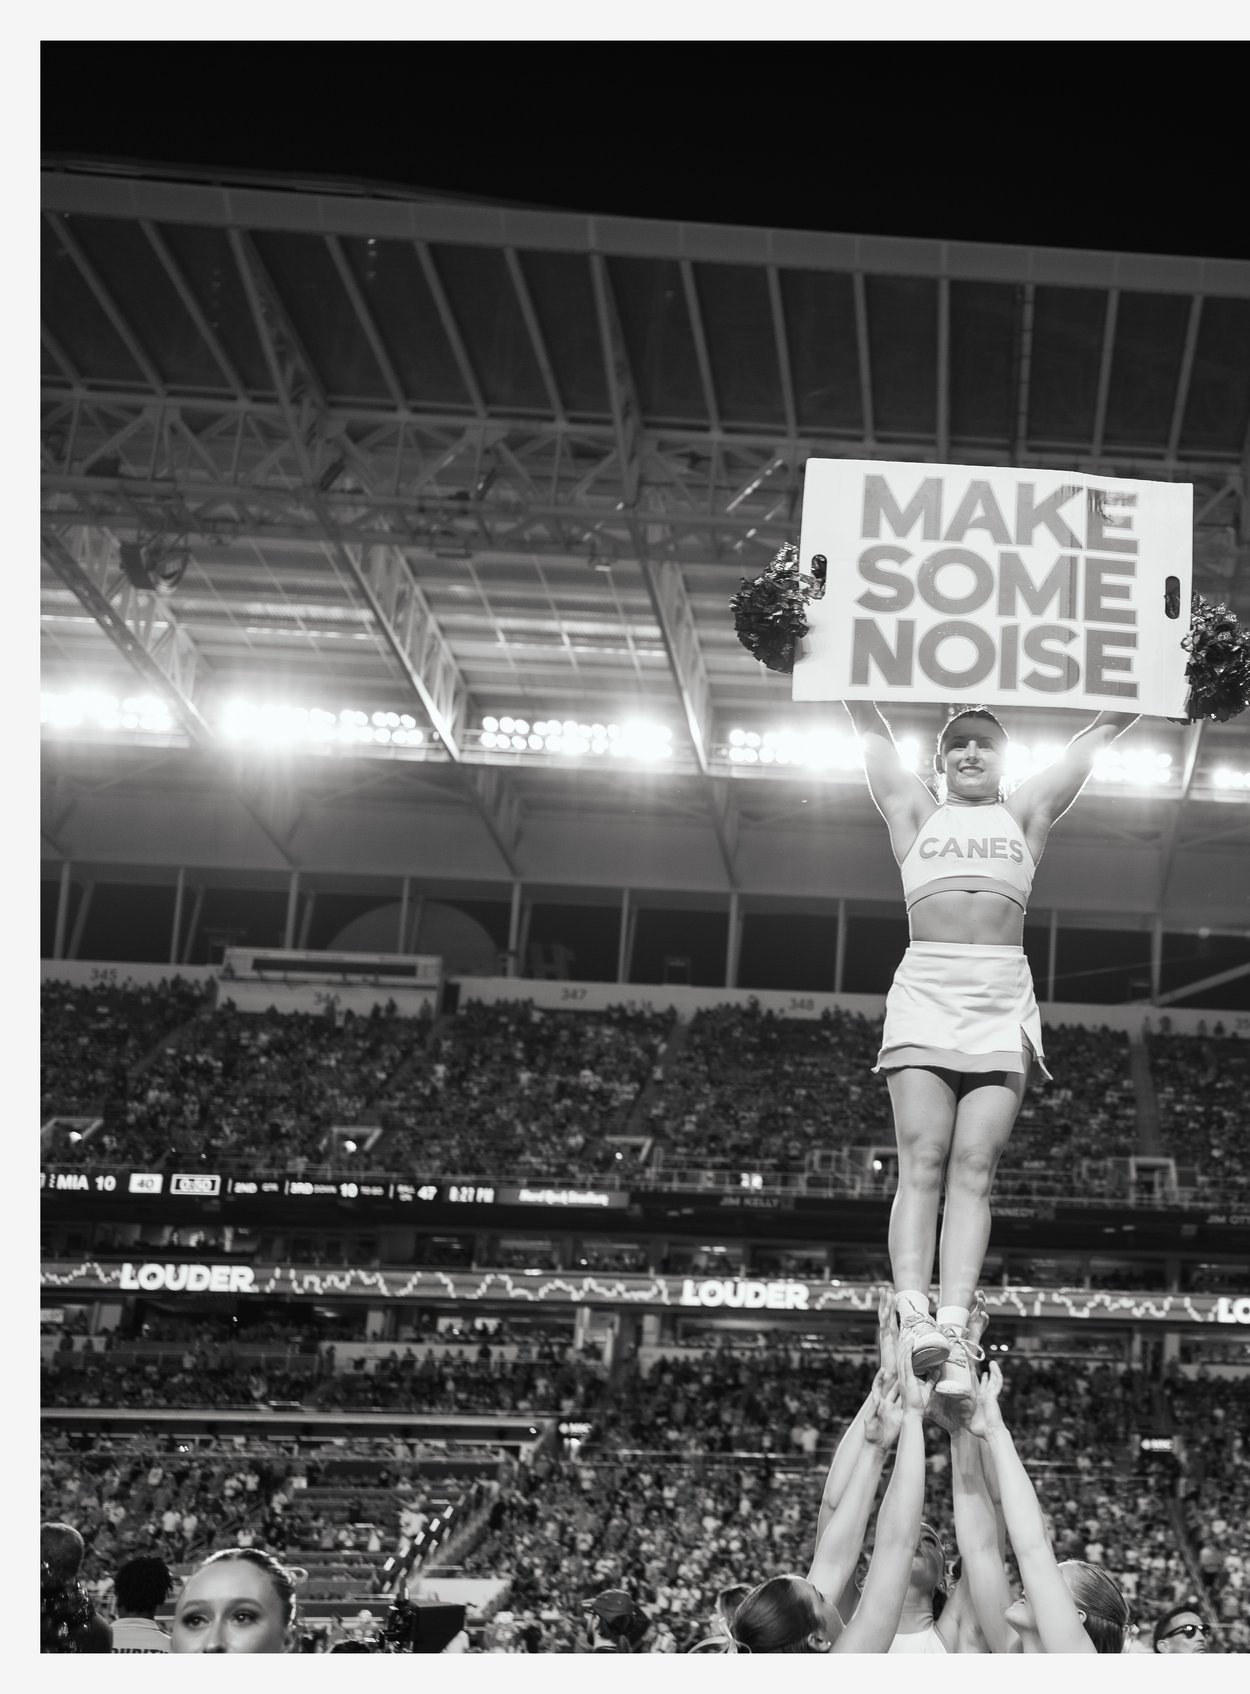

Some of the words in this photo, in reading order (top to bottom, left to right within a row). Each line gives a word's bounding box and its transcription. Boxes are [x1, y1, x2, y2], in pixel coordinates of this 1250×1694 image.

[860, 473, 1139, 555] MAKE
[854, 543, 1139, 627] SOME
[848, 615, 1140, 700] NOISE
[919, 837, 1024, 864] CANES
[56, 1174, 90, 1191] MIA
[95, 1174, 117, 1192] 10
[138, 1178, 155, 1190] 40
[339, 1183, 359, 1198] 10
[417, 1185, 438, 1201] 47
[119, 1262, 255, 1293] LOUDER
[679, 1279, 810, 1311] LOUDER
